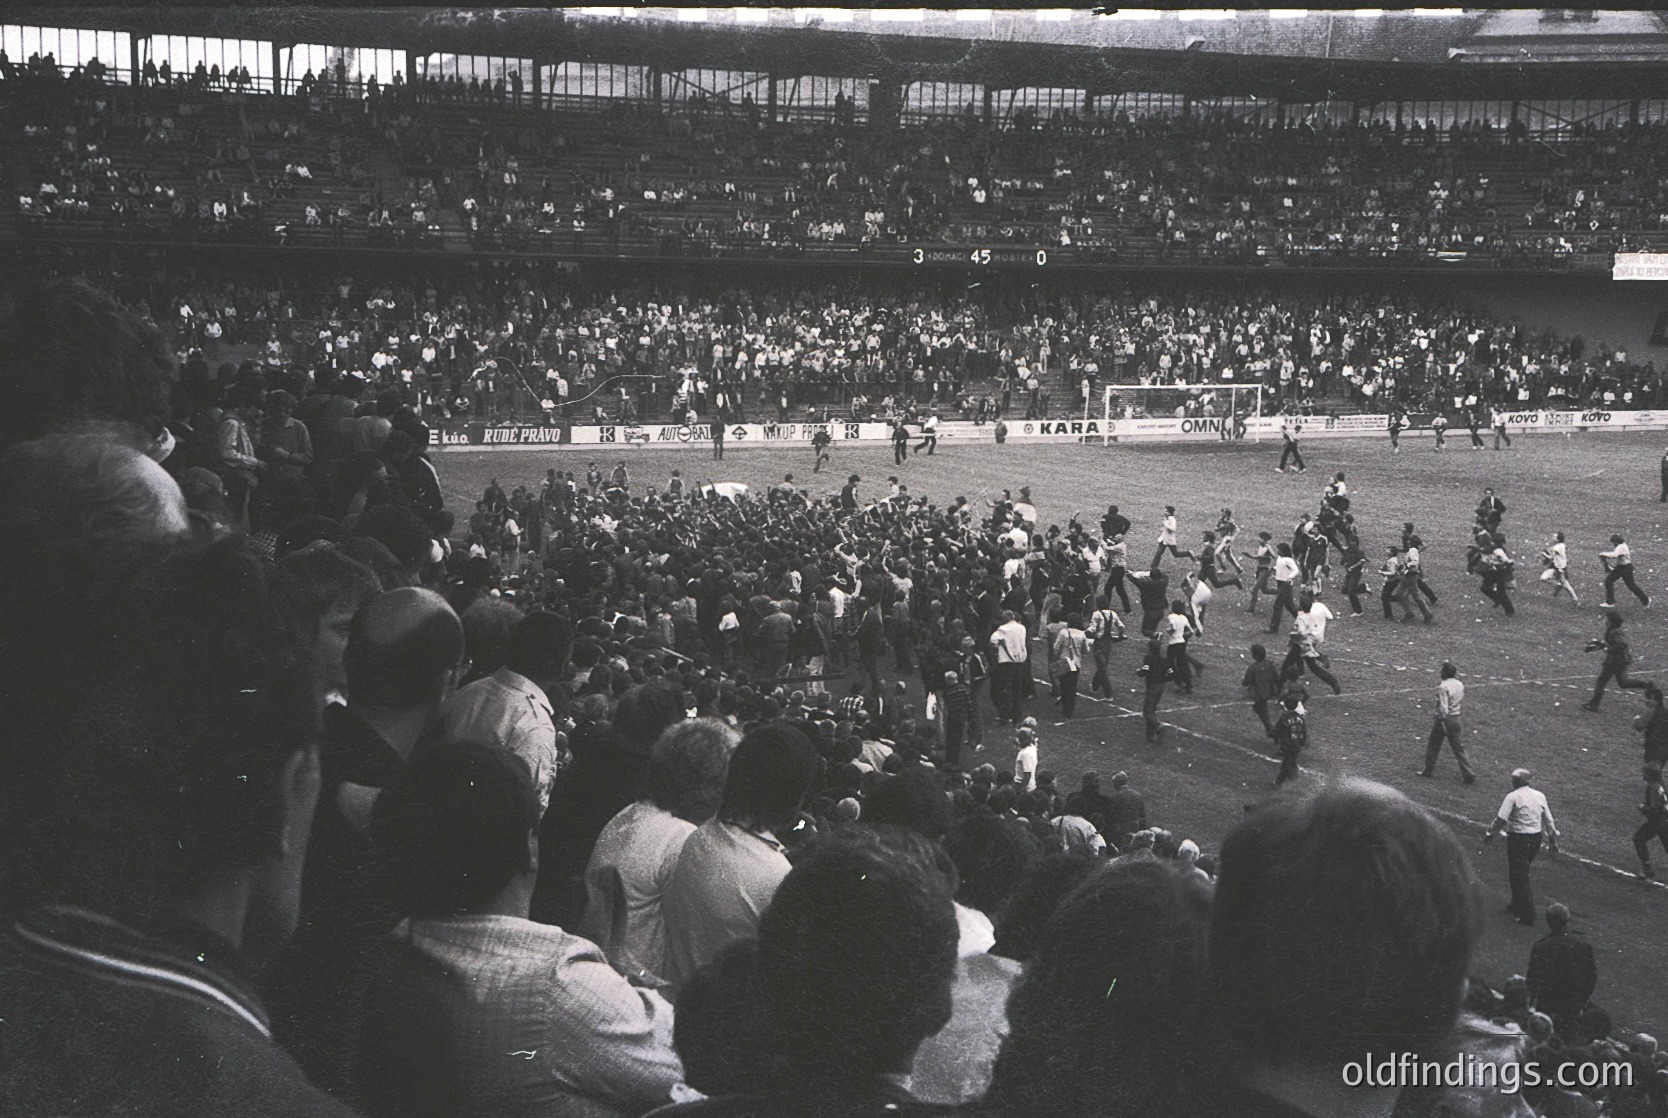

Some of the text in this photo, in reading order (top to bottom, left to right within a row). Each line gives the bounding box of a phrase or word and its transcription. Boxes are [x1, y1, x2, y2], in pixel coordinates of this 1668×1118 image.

[913, 248, 924, 264] 3
[970, 249, 991, 264] 45
[1036, 250, 1047, 266] 0
[1508, 414, 1538, 424] KOVO
[1581, 412, 1611, 422] KOVO
[1040, 421, 1099, 435] KARA
